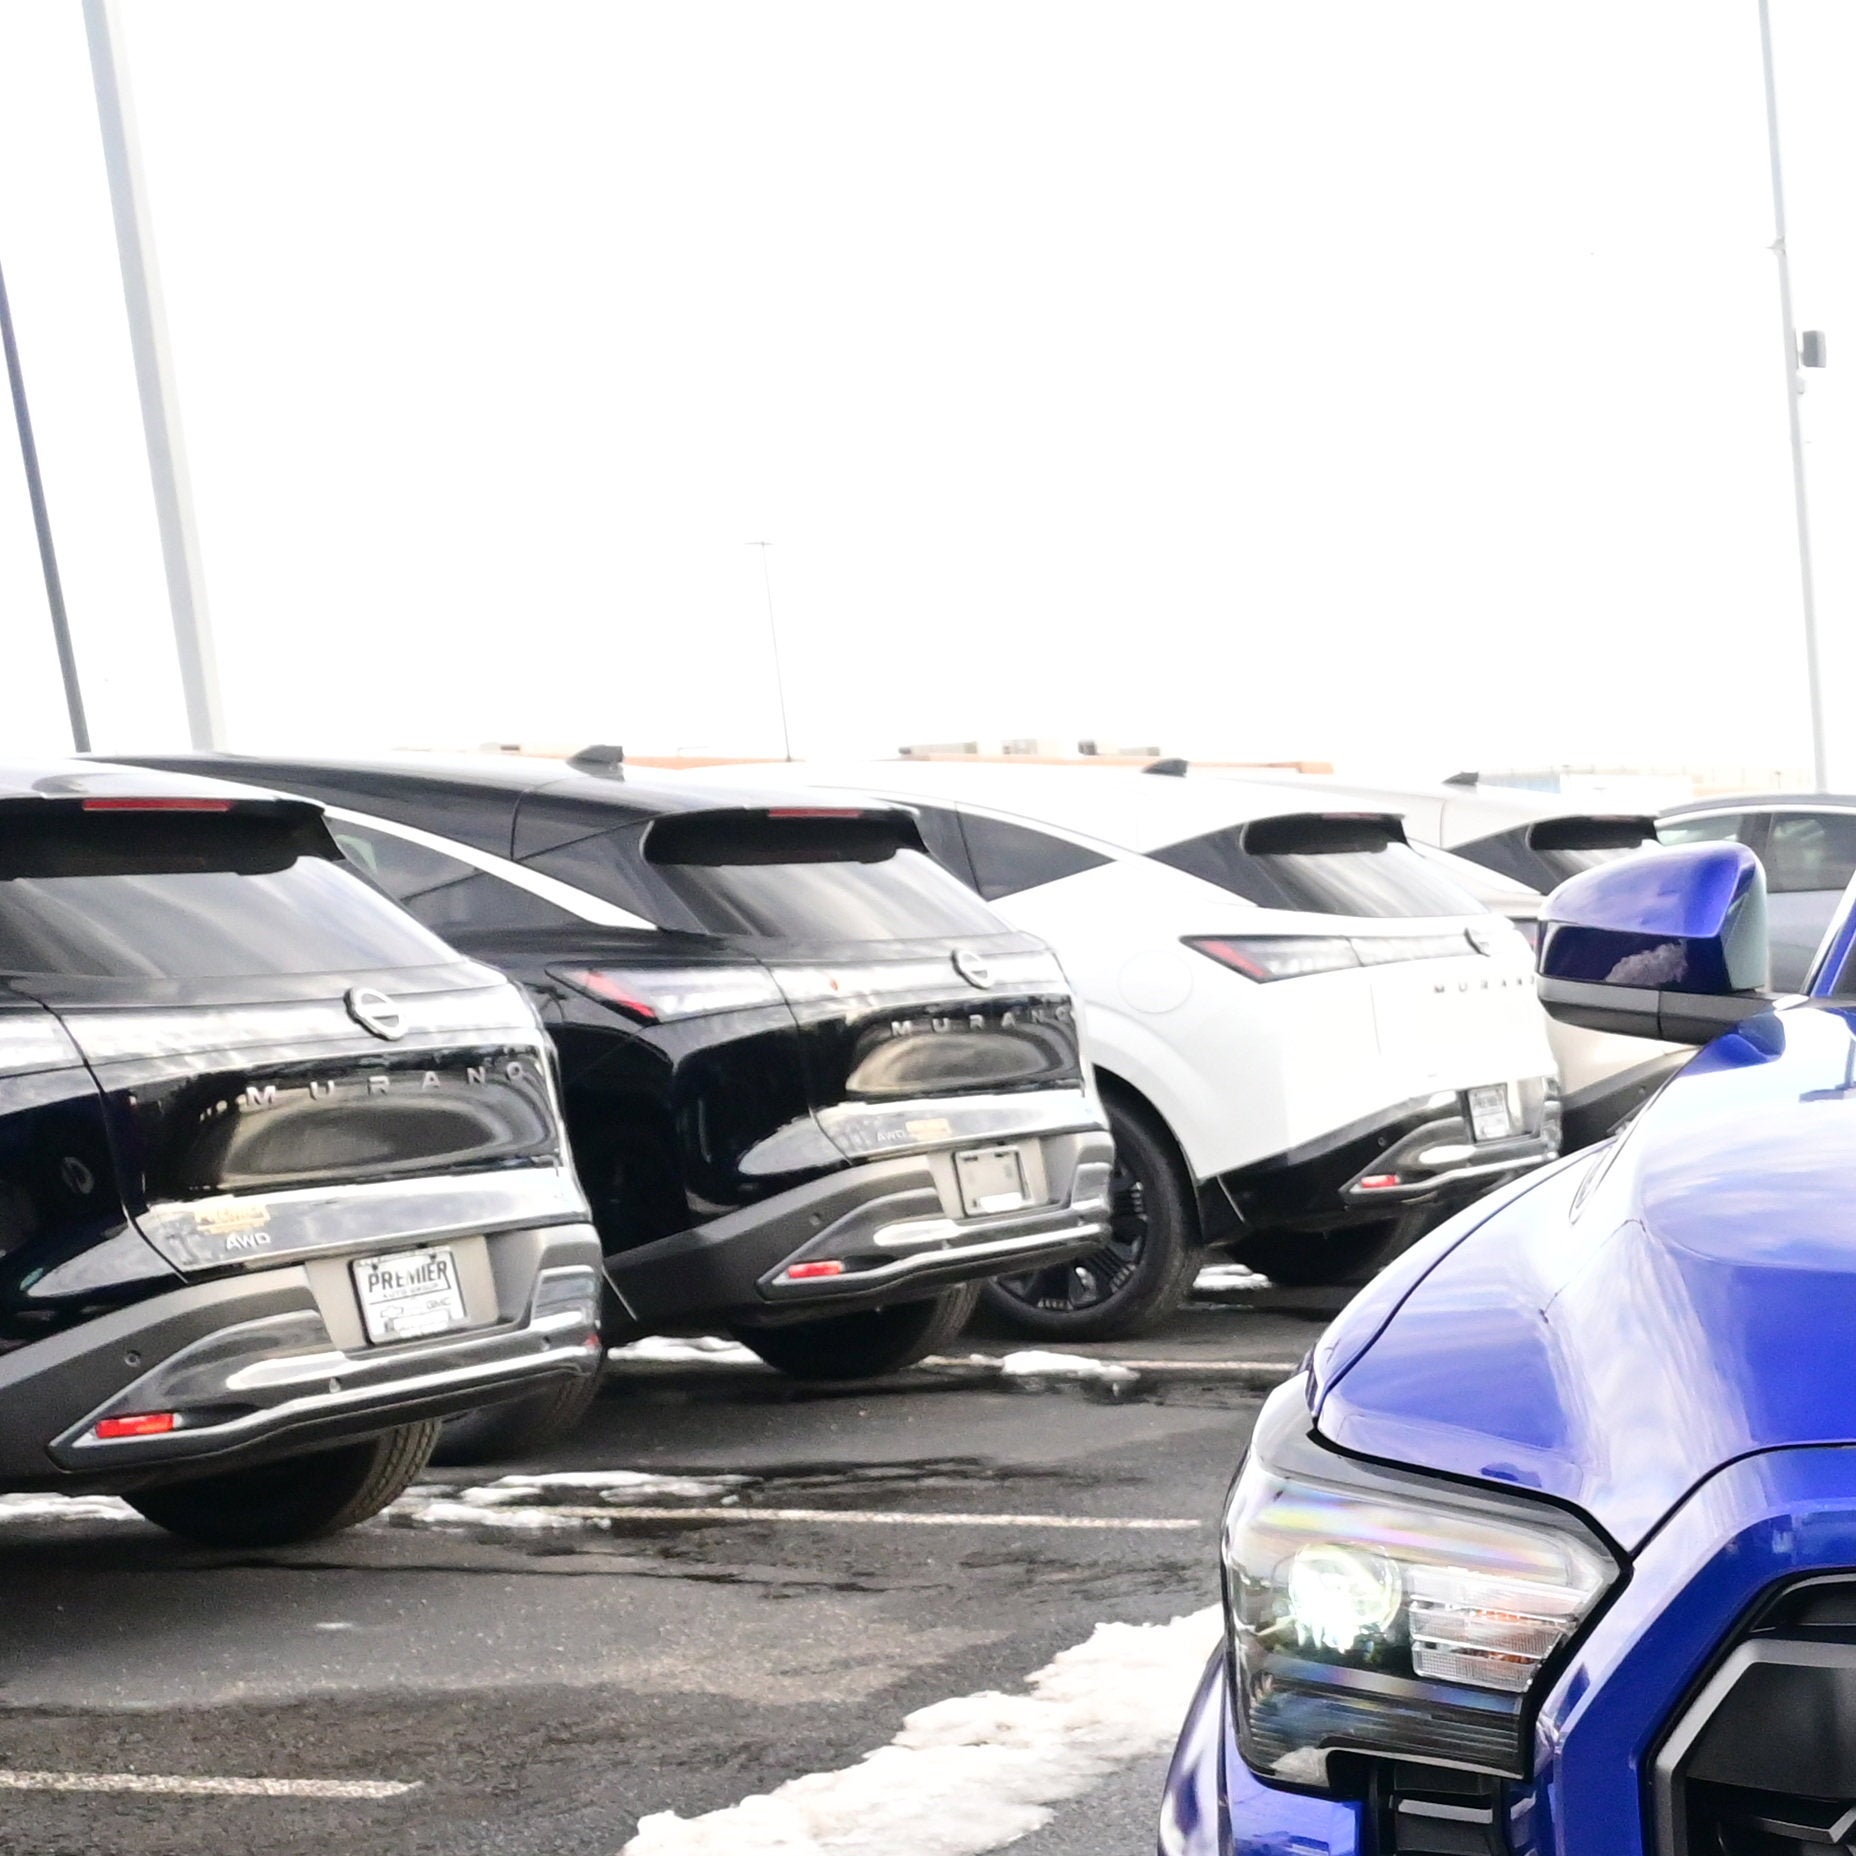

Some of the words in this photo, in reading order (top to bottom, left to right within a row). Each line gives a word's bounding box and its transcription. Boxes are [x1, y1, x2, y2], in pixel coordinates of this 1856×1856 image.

[890, 1005, 1072, 1036] MURANO
[245, 1061, 524, 1107] MURANO
[226, 1232, 271, 1251] AWD
[368, 1260, 450, 1293] PREMIER
